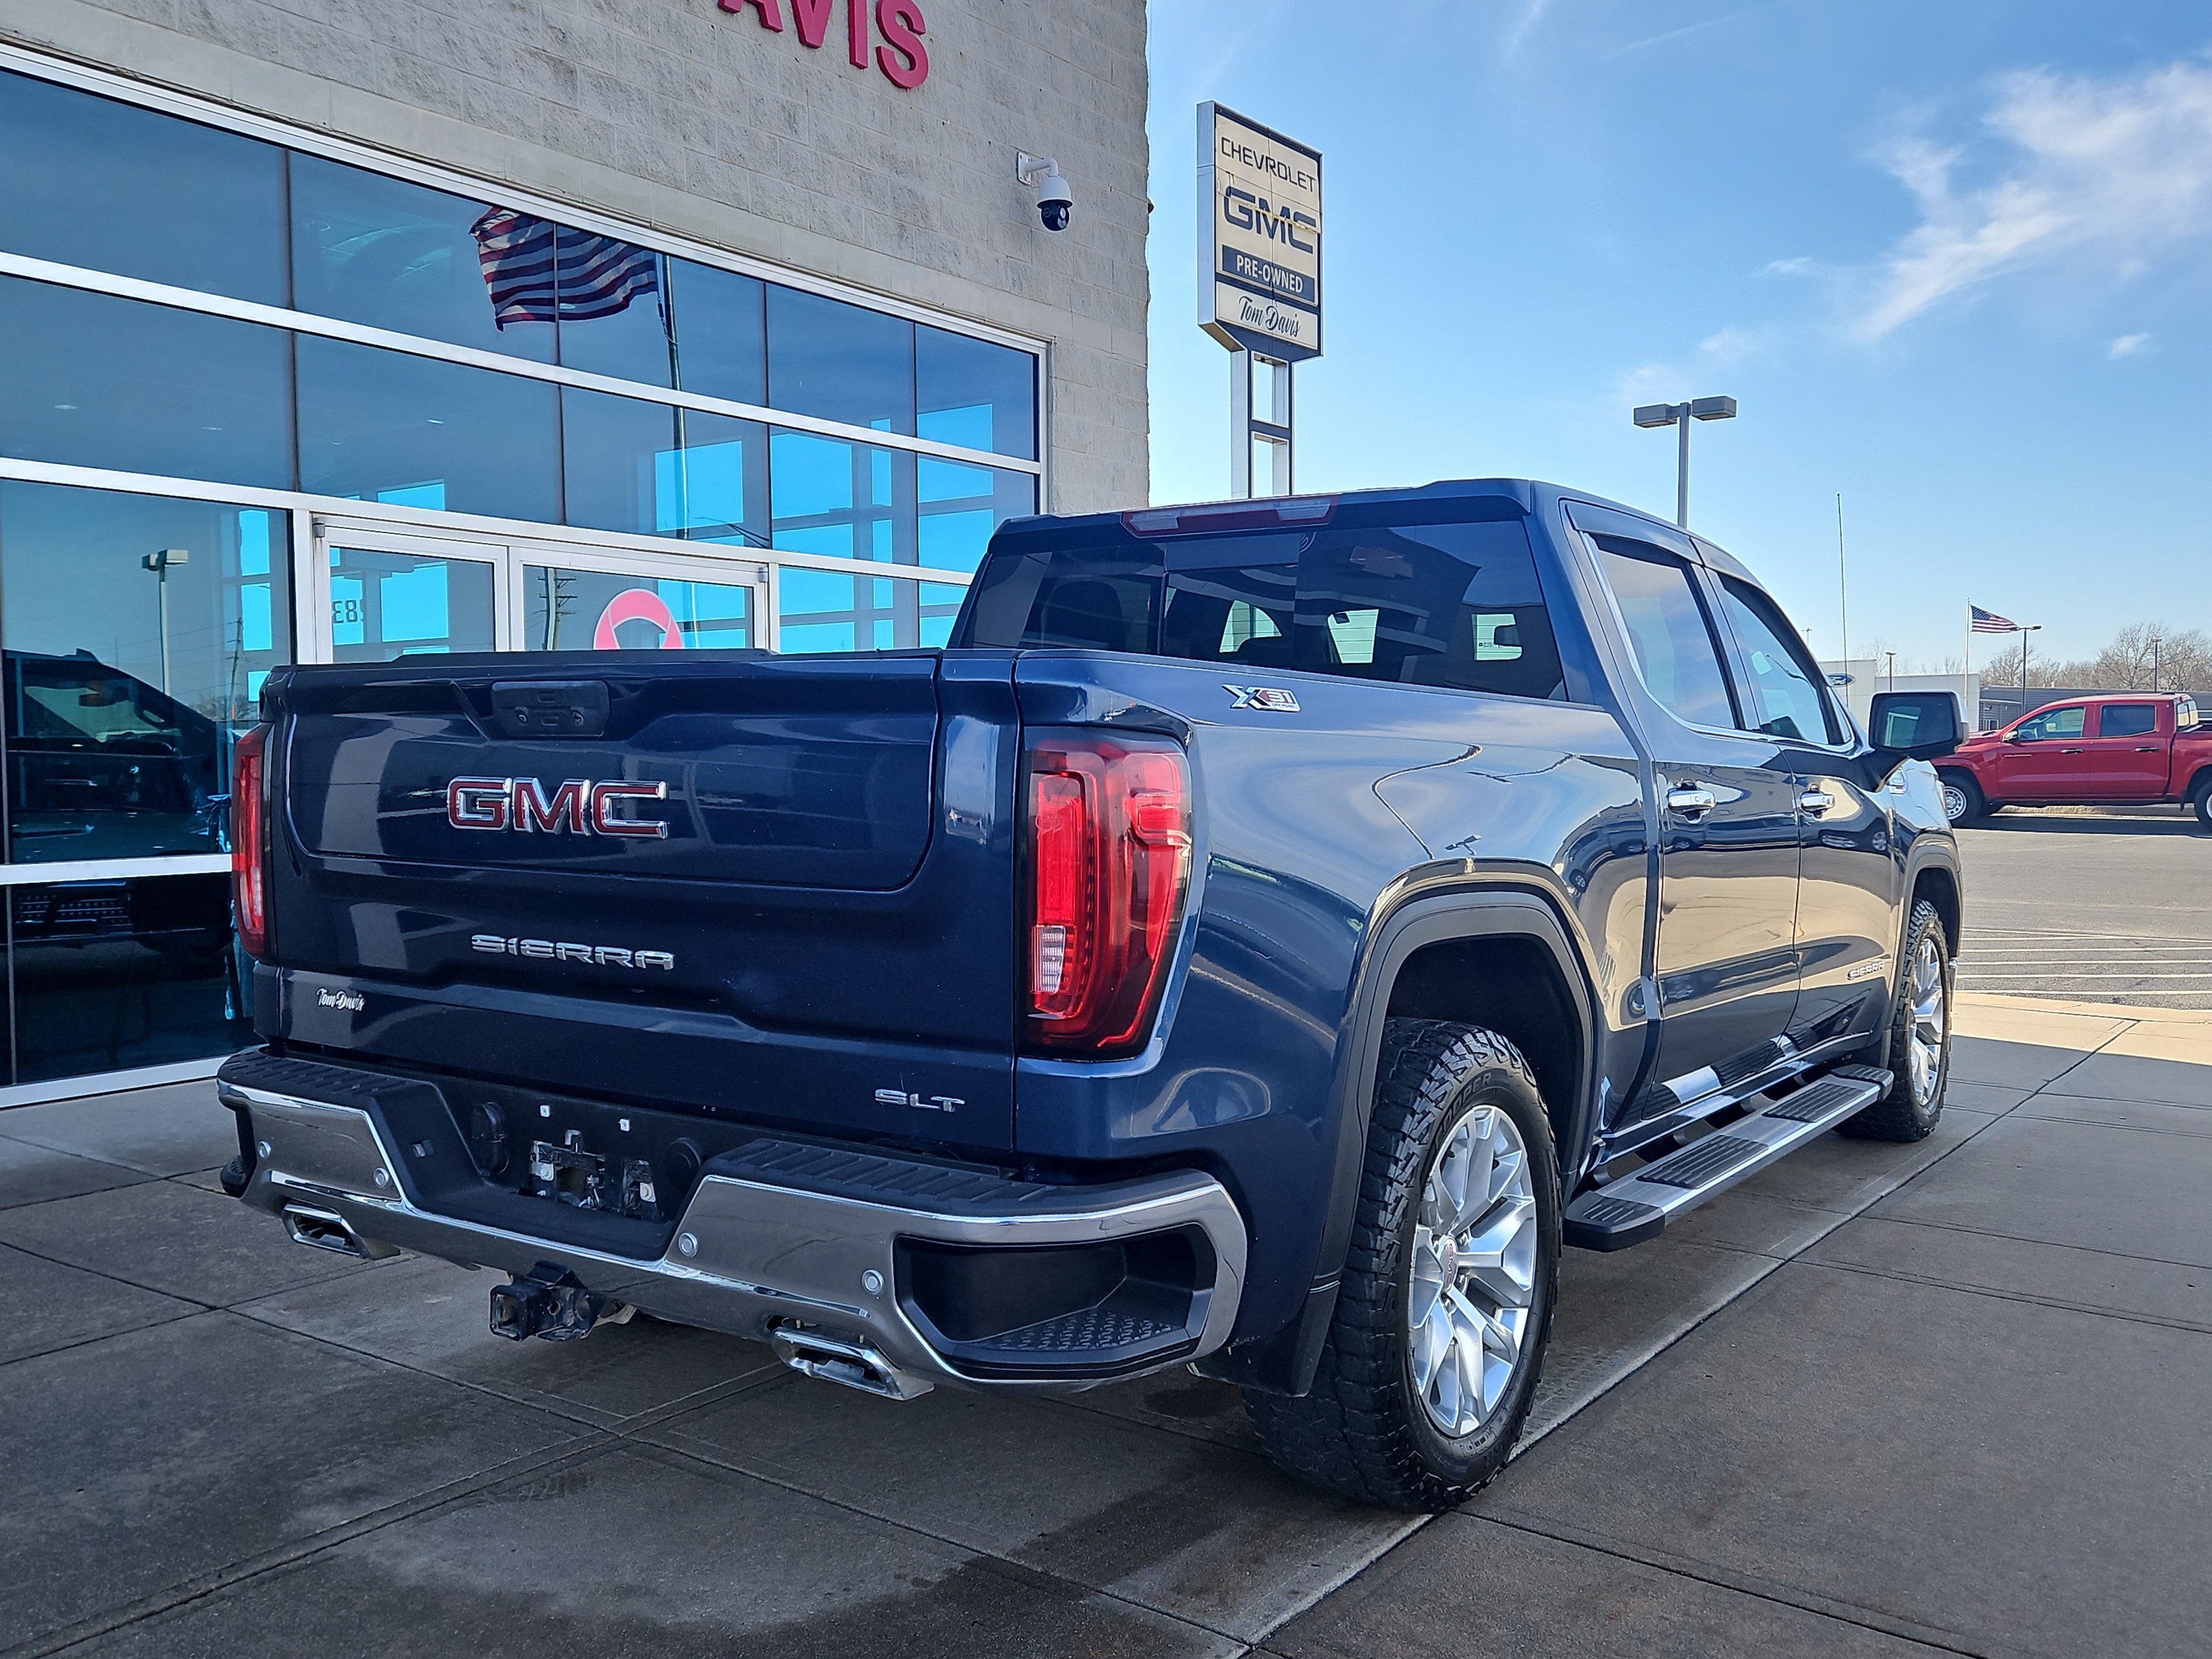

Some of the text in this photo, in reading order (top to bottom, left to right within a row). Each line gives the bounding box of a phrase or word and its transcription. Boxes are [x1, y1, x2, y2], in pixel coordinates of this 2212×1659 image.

[1221, 137, 1316, 192] CHEVROLET
[1224, 185, 1316, 254] GMC
[1237, 254, 1303, 293] PRE-OWNED
[1239, 295, 1301, 337] Tom Davis
[447, 776, 668, 839] GMC
[471, 934, 674, 970] SIERRA
[317, 988, 366, 1011] Tom Davis
[875, 1089, 965, 1112] SLT
